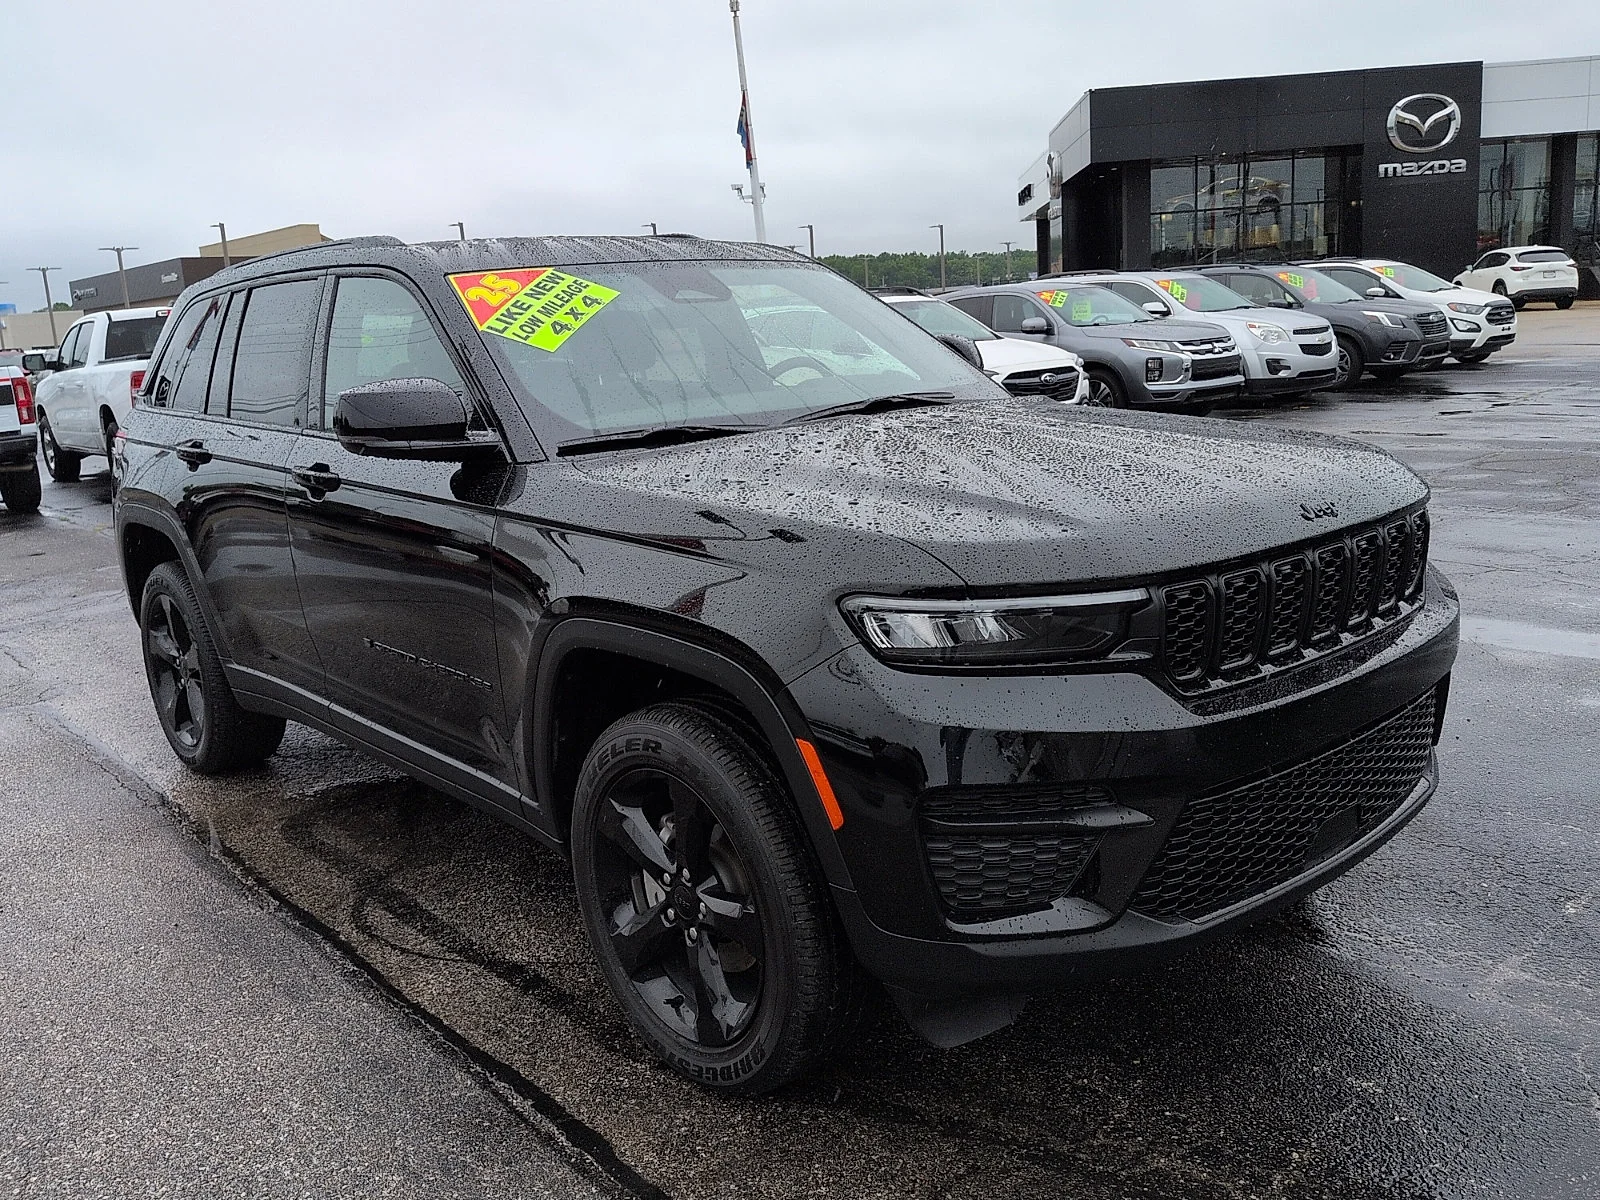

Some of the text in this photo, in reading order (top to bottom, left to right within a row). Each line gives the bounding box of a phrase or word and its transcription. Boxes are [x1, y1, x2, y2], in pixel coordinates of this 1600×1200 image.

[465, 273, 522, 307] 25
[486, 271, 566, 335] LIKE NEW
[512, 279, 590, 341] LOW MILEAGE
[1299, 501, 1339, 521] Jeep
